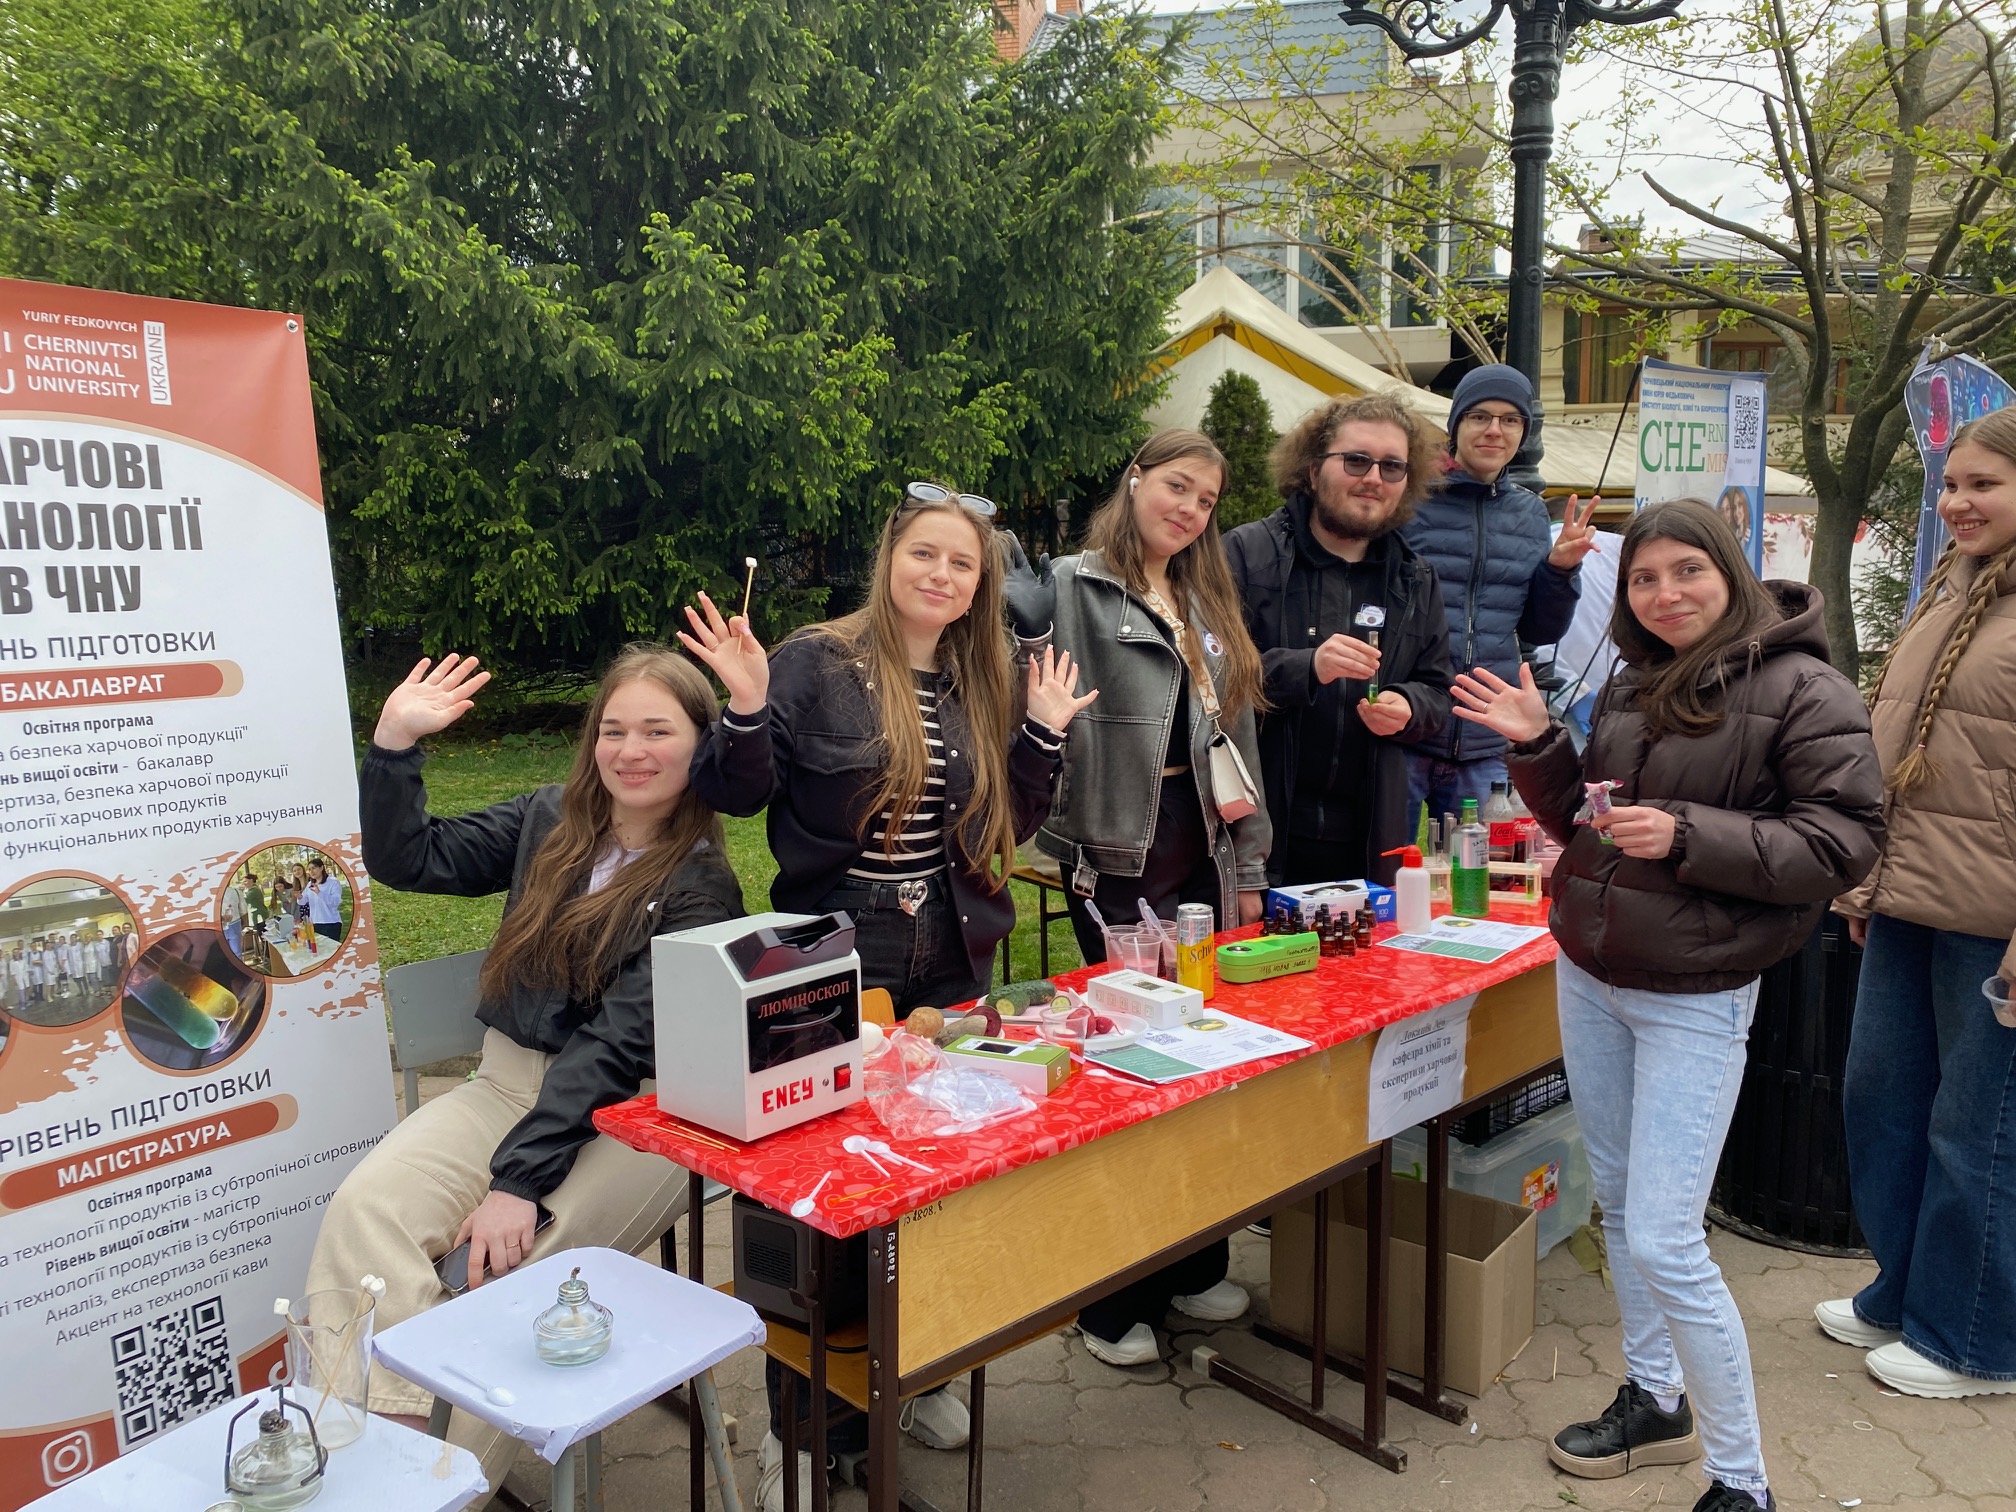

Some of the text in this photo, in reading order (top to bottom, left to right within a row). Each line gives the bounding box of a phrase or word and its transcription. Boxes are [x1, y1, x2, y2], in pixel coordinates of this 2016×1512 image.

[22, 310, 138, 333] YURIY FEDKOVYCH
[24, 334, 138, 359] CHERNIVTSI
[25, 354, 126, 379] NATIONAL
[147, 324, 170, 402] UKRAINE
[27, 374, 141, 399] UNIVERSITY
[1640, 419, 1706, 473] CHE
[0, 497, 204, 551] НОЛОГІЇ
[45, 565, 142, 614] ЧНУ
[48, 630, 217, 662] ПІДГОТОВКИ
[1, 673, 166, 703] БАКАЛАВРАТ
[10, 742, 82, 760] безпека
[87, 733, 163, 756] харчової
[167, 725, 250, 750] продукції"
[23, 714, 154, 736] Освітня програма
[23, 764, 70, 784] вищої
[73, 760, 119, 778] освіти
[137, 752, 214, 773] бакалавр
[0, 764, 289, 813] ертиза, безпека харчової продукції
[60, 804, 143, 827] харчових
[147, 793, 228, 817] продуктів
[3, 803, 323, 860] функціональних продуктів харчування
[758, 980, 850, 1020] ЛЮМІНОСКОП
[1382, 1050, 1459, 1090] експертизи харчової
[1392, 1048, 1424, 1066] кафедра
[1443, 1036, 1452, 1046] та
[111, 1068, 273, 1131] ПІДГОТОВКИ
[762, 1076, 814, 1114] ENEY
[1403, 1076, 1440, 1102] продукції
[57, 1121, 231, 1188] МАГІСТРАТУРА
[13, 1219, 105, 1262] технології
[109, 1194, 191, 1237] продуктів
[196, 1187, 208, 1204] із
[212, 1154, 311, 1199] субтропічної
[87, 1164, 213, 1213] Освітня програма
[14, 1267, 105, 1312] технології
[109, 1241, 192, 1284] продуктів
[196, 1233, 209, 1250] із
[212, 1197, 311, 1244] субтропічної
[45, 1248, 96, 1276] Рівень
[99, 1233, 144, 1260] вищої
[147, 1217, 190, 1242] освіти
[203, 1193, 261, 1222] магістр
[45, 1233, 272, 1325] Аналіз, експертиза безпека
[56, 1256, 269, 1346] Акцент на технології кави
